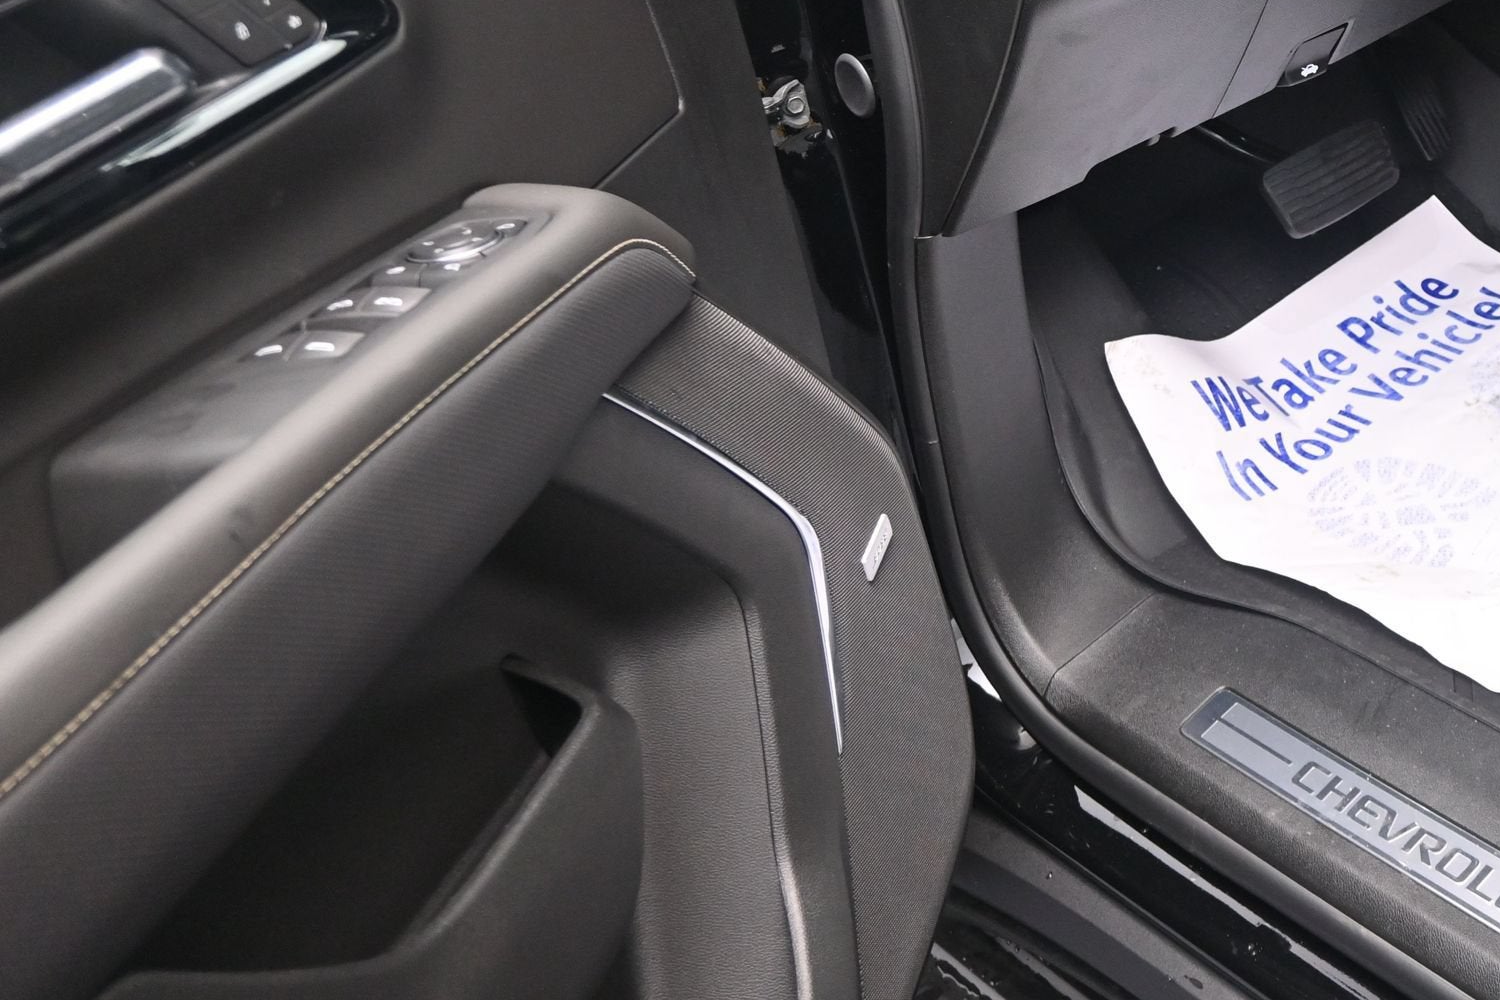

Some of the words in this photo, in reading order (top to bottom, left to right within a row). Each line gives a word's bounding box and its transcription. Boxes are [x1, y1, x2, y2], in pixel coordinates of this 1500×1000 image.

[1242, 348, 1358, 417] Take
[1336, 277, 1459, 354] Pride
[1216, 450, 1279, 501] In
[1259, 404, 1373, 475] Your
